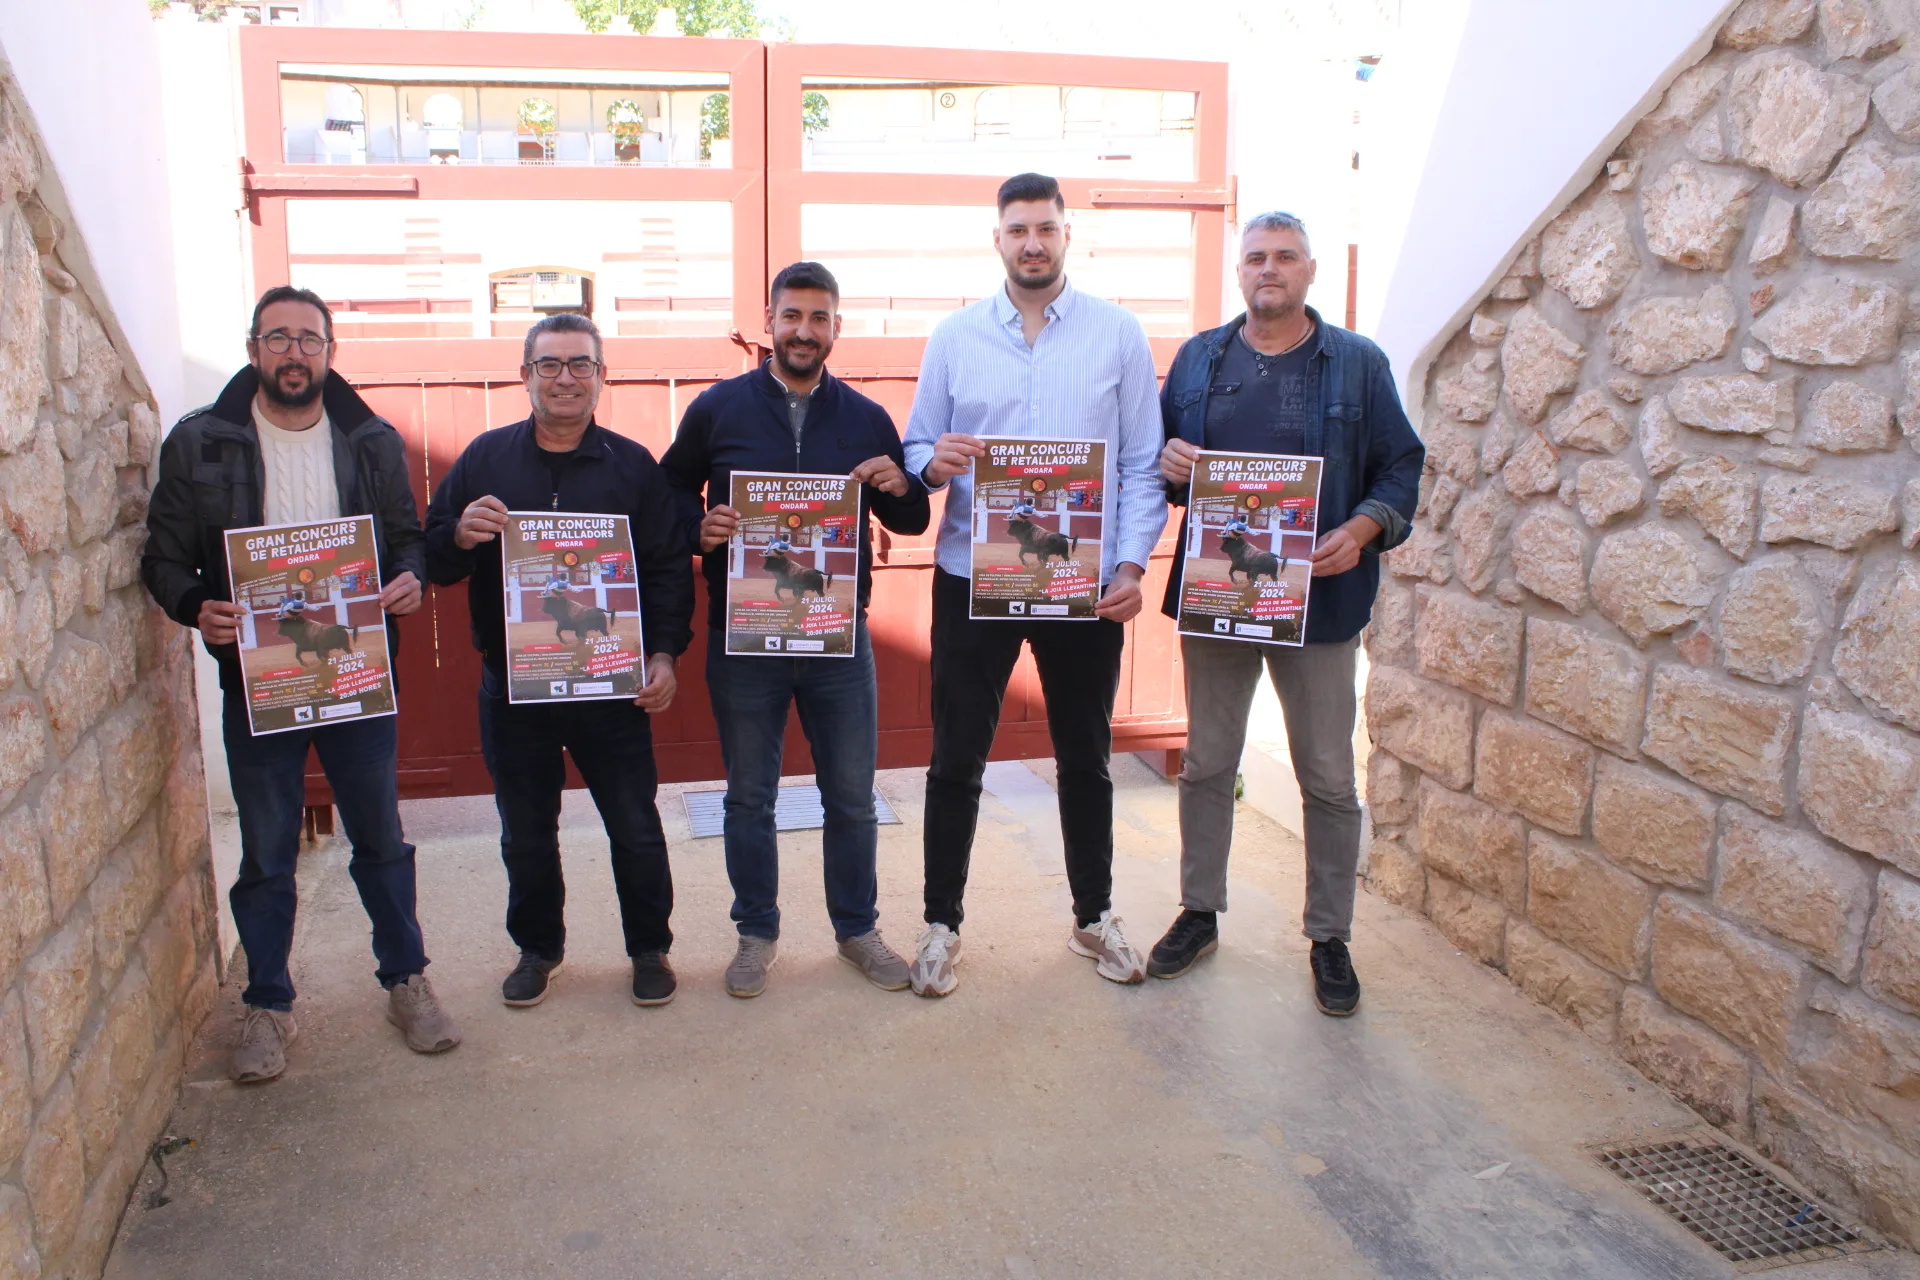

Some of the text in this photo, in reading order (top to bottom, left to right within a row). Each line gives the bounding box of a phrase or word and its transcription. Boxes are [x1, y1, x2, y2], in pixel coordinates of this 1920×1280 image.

[990, 444, 1090, 455] GRAN CONCURS
[993, 456, 1088, 465] DE RETALLADORS
[1209, 460, 1306, 472] GRAN CONCURS
[1210, 472, 1303, 481] DE RETALLADORS
[747, 481, 845, 491] GRAN CONCURS
[768, 492, 842, 501] RETALLADORS
[519, 518, 615, 531] GRAN CONCURS
[246, 522, 357, 550] GRAN CONCURS
[523, 530, 613, 541] DE RETALLADORS
[250, 535, 355, 561] DE RETALLADORS
[287, 554, 319, 565] ONDARA
[1053, 568, 1078, 578] 2024
[1260, 589, 1285, 597] 2024
[809, 604, 833, 613] 2024
[596, 635, 622, 643] JULIOL
[594, 644, 619, 654] 2024
[328, 651, 367, 665] 21 JULIOL
[337, 662, 364, 674] 2024
[593, 670, 610, 678] 20:00
[612, 666, 633, 675] HORES
[337, 675, 351, 684] PLAÇA
[340, 683, 381, 699] 20:00 HORES
